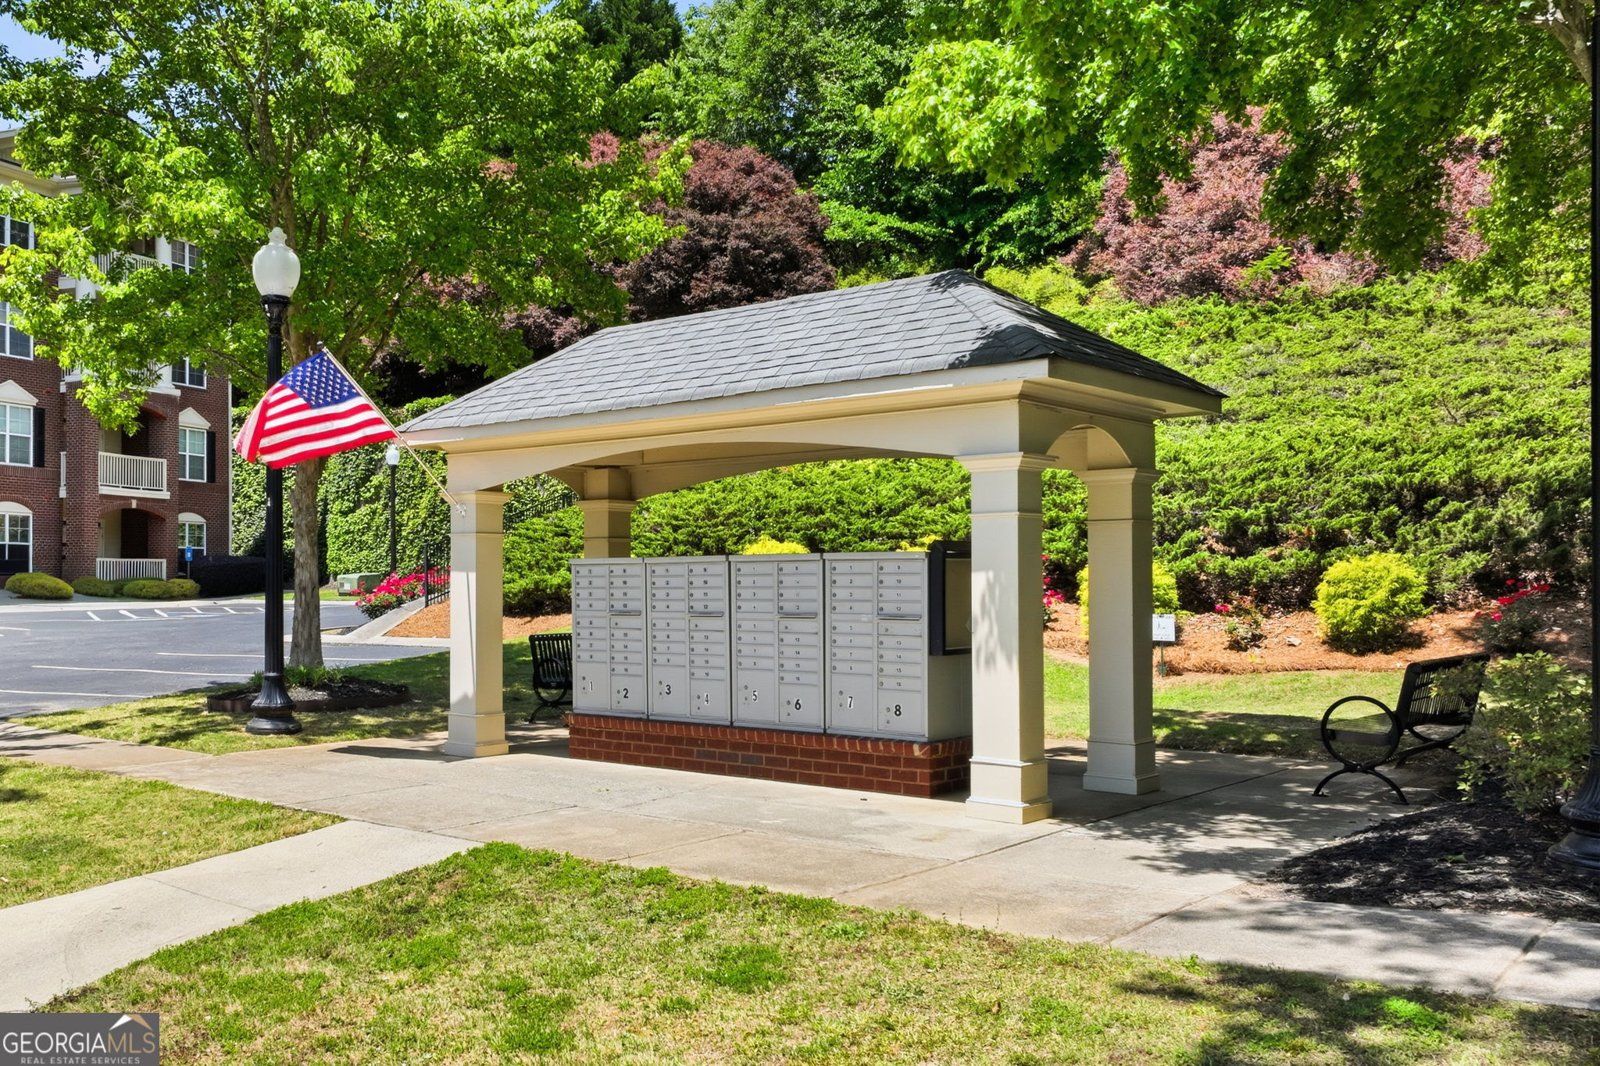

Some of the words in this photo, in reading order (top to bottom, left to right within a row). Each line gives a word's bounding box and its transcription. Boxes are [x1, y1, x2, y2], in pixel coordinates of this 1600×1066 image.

[588, 680, 594, 692] 1
[665, 684, 672, 696] 3
[622, 687, 629, 699] 2
[704, 693, 710, 705] 4
[752, 690, 758, 702] 5
[794, 698, 802, 711] 6
[847, 696, 854, 709] 7
[894, 704, 902, 717] 8
